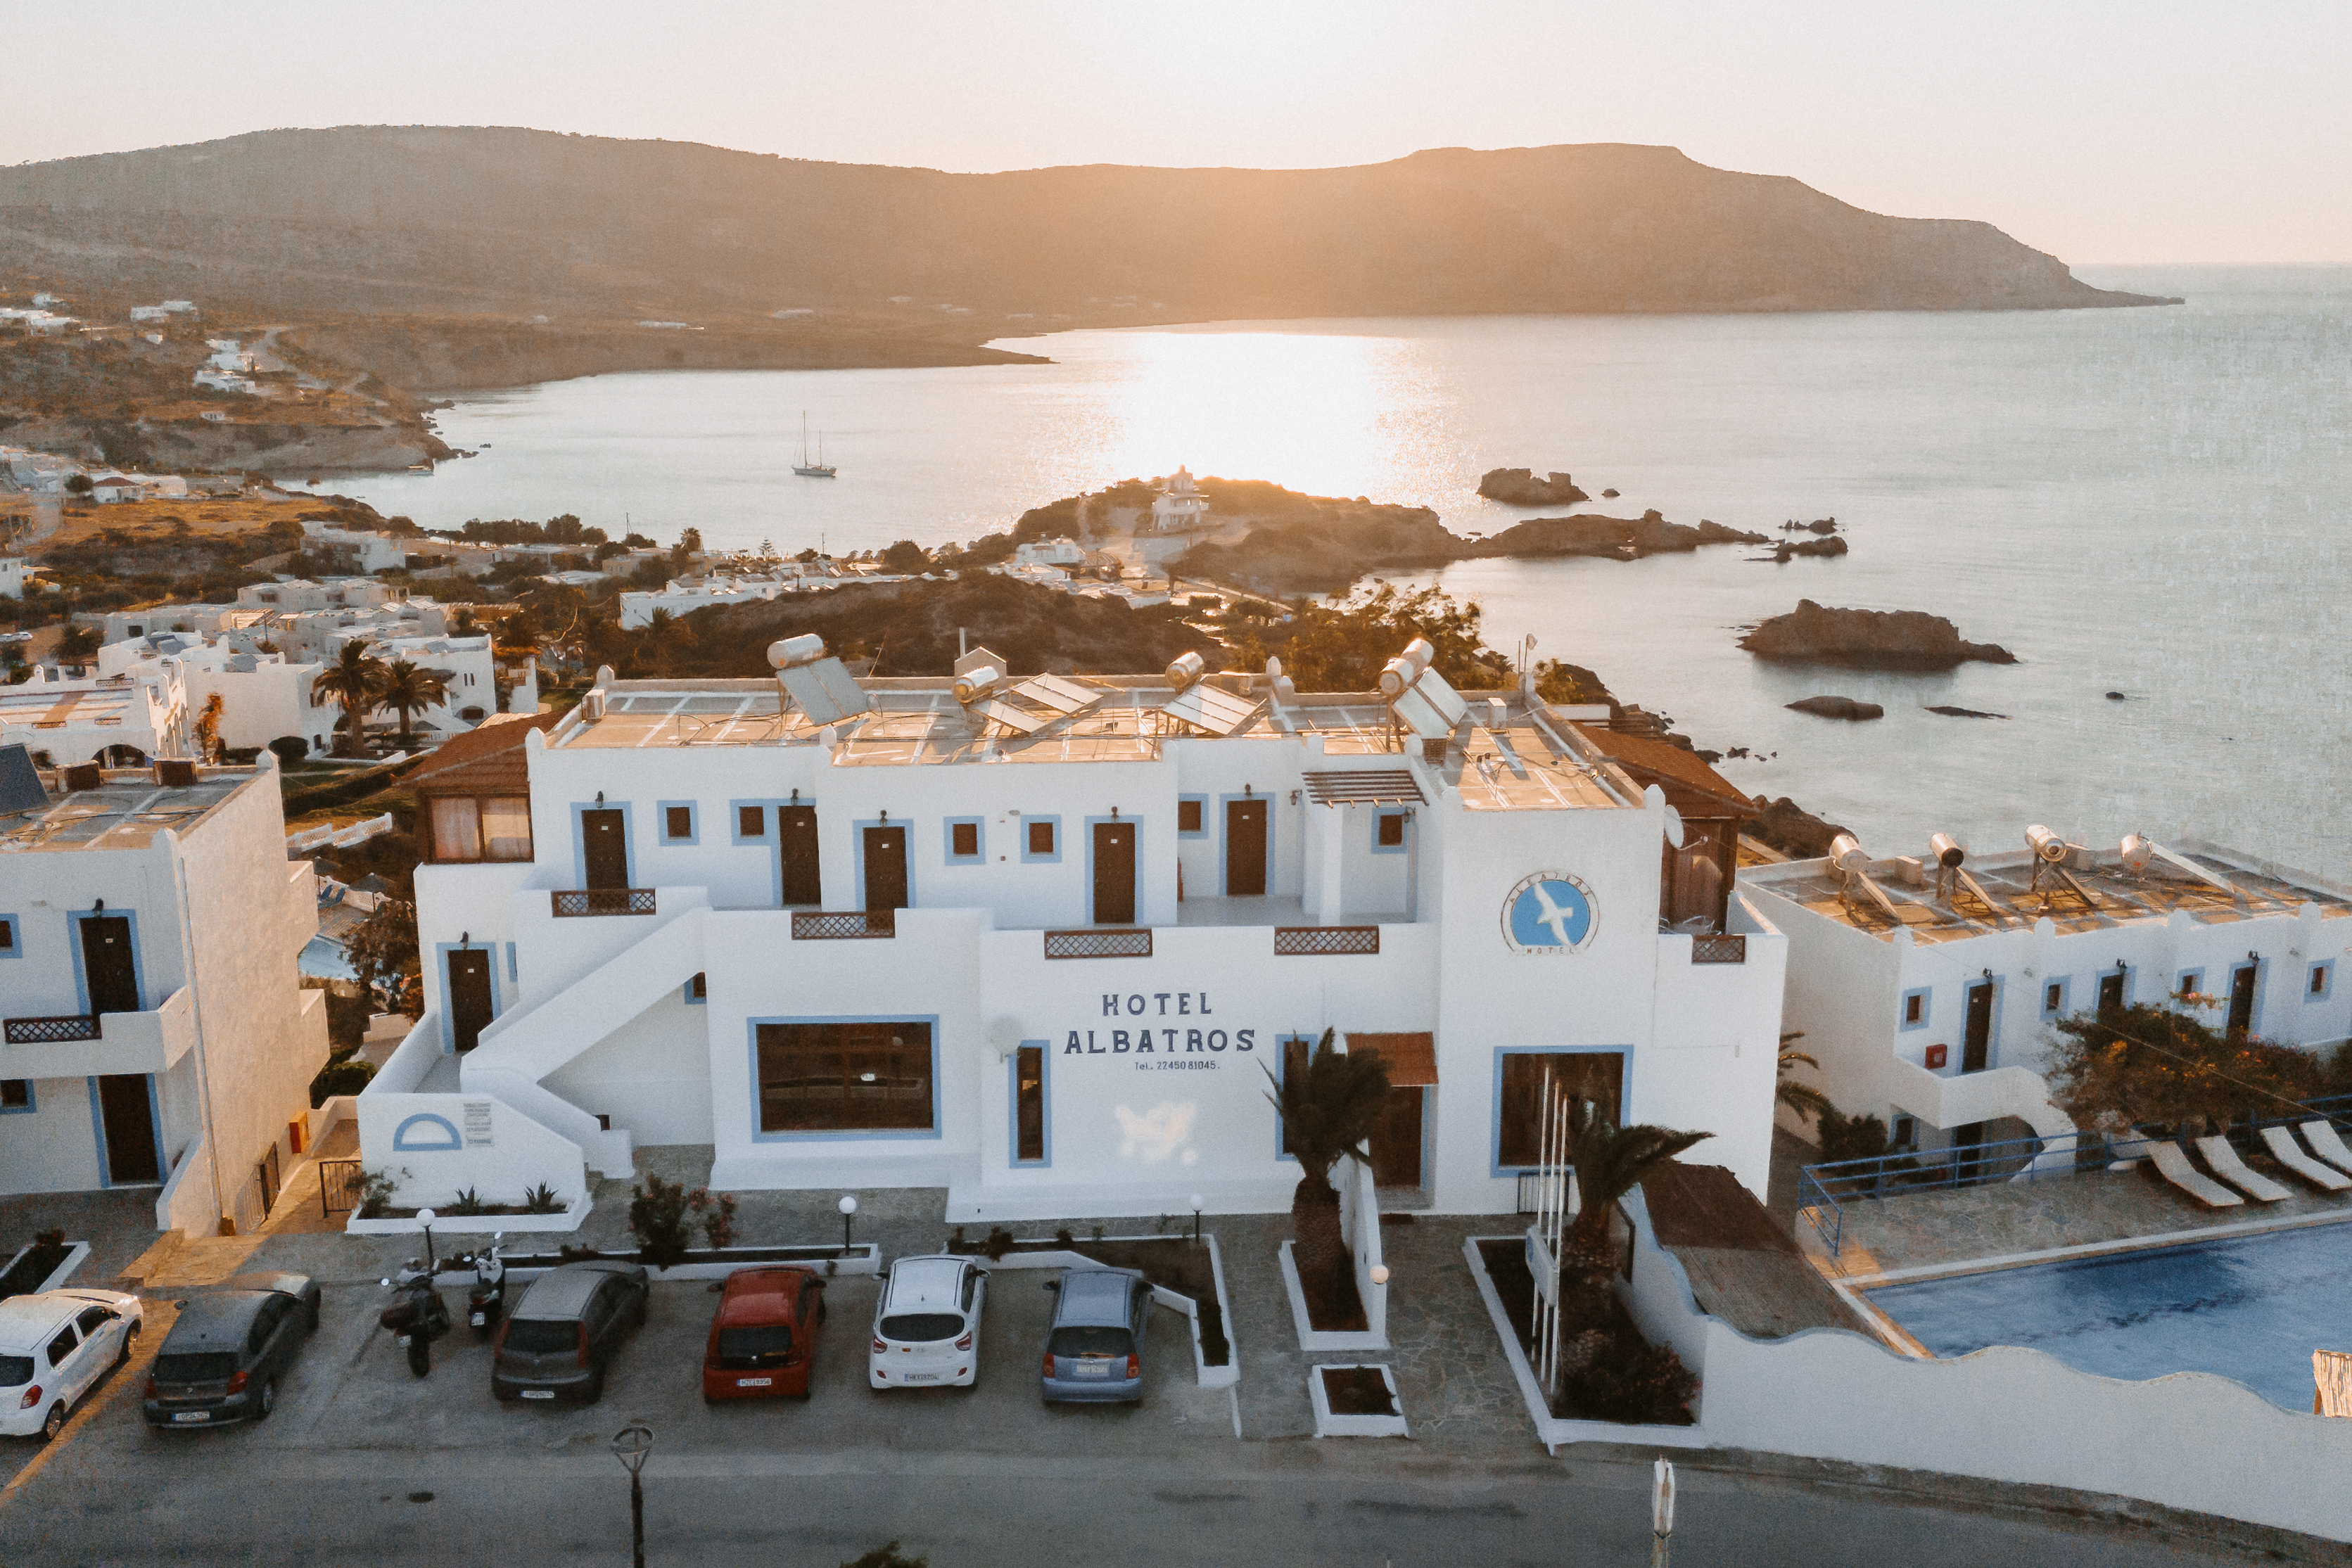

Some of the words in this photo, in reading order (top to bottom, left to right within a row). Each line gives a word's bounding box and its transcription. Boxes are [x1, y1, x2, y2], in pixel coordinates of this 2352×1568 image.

[1509, 872, 1591, 903] ALBATROS
[1102, 992, 1212, 1016] HOTEL
[1063, 1028, 1255, 1054] ALBATROS
[1134, 1061, 1154, 1071] Tel.
